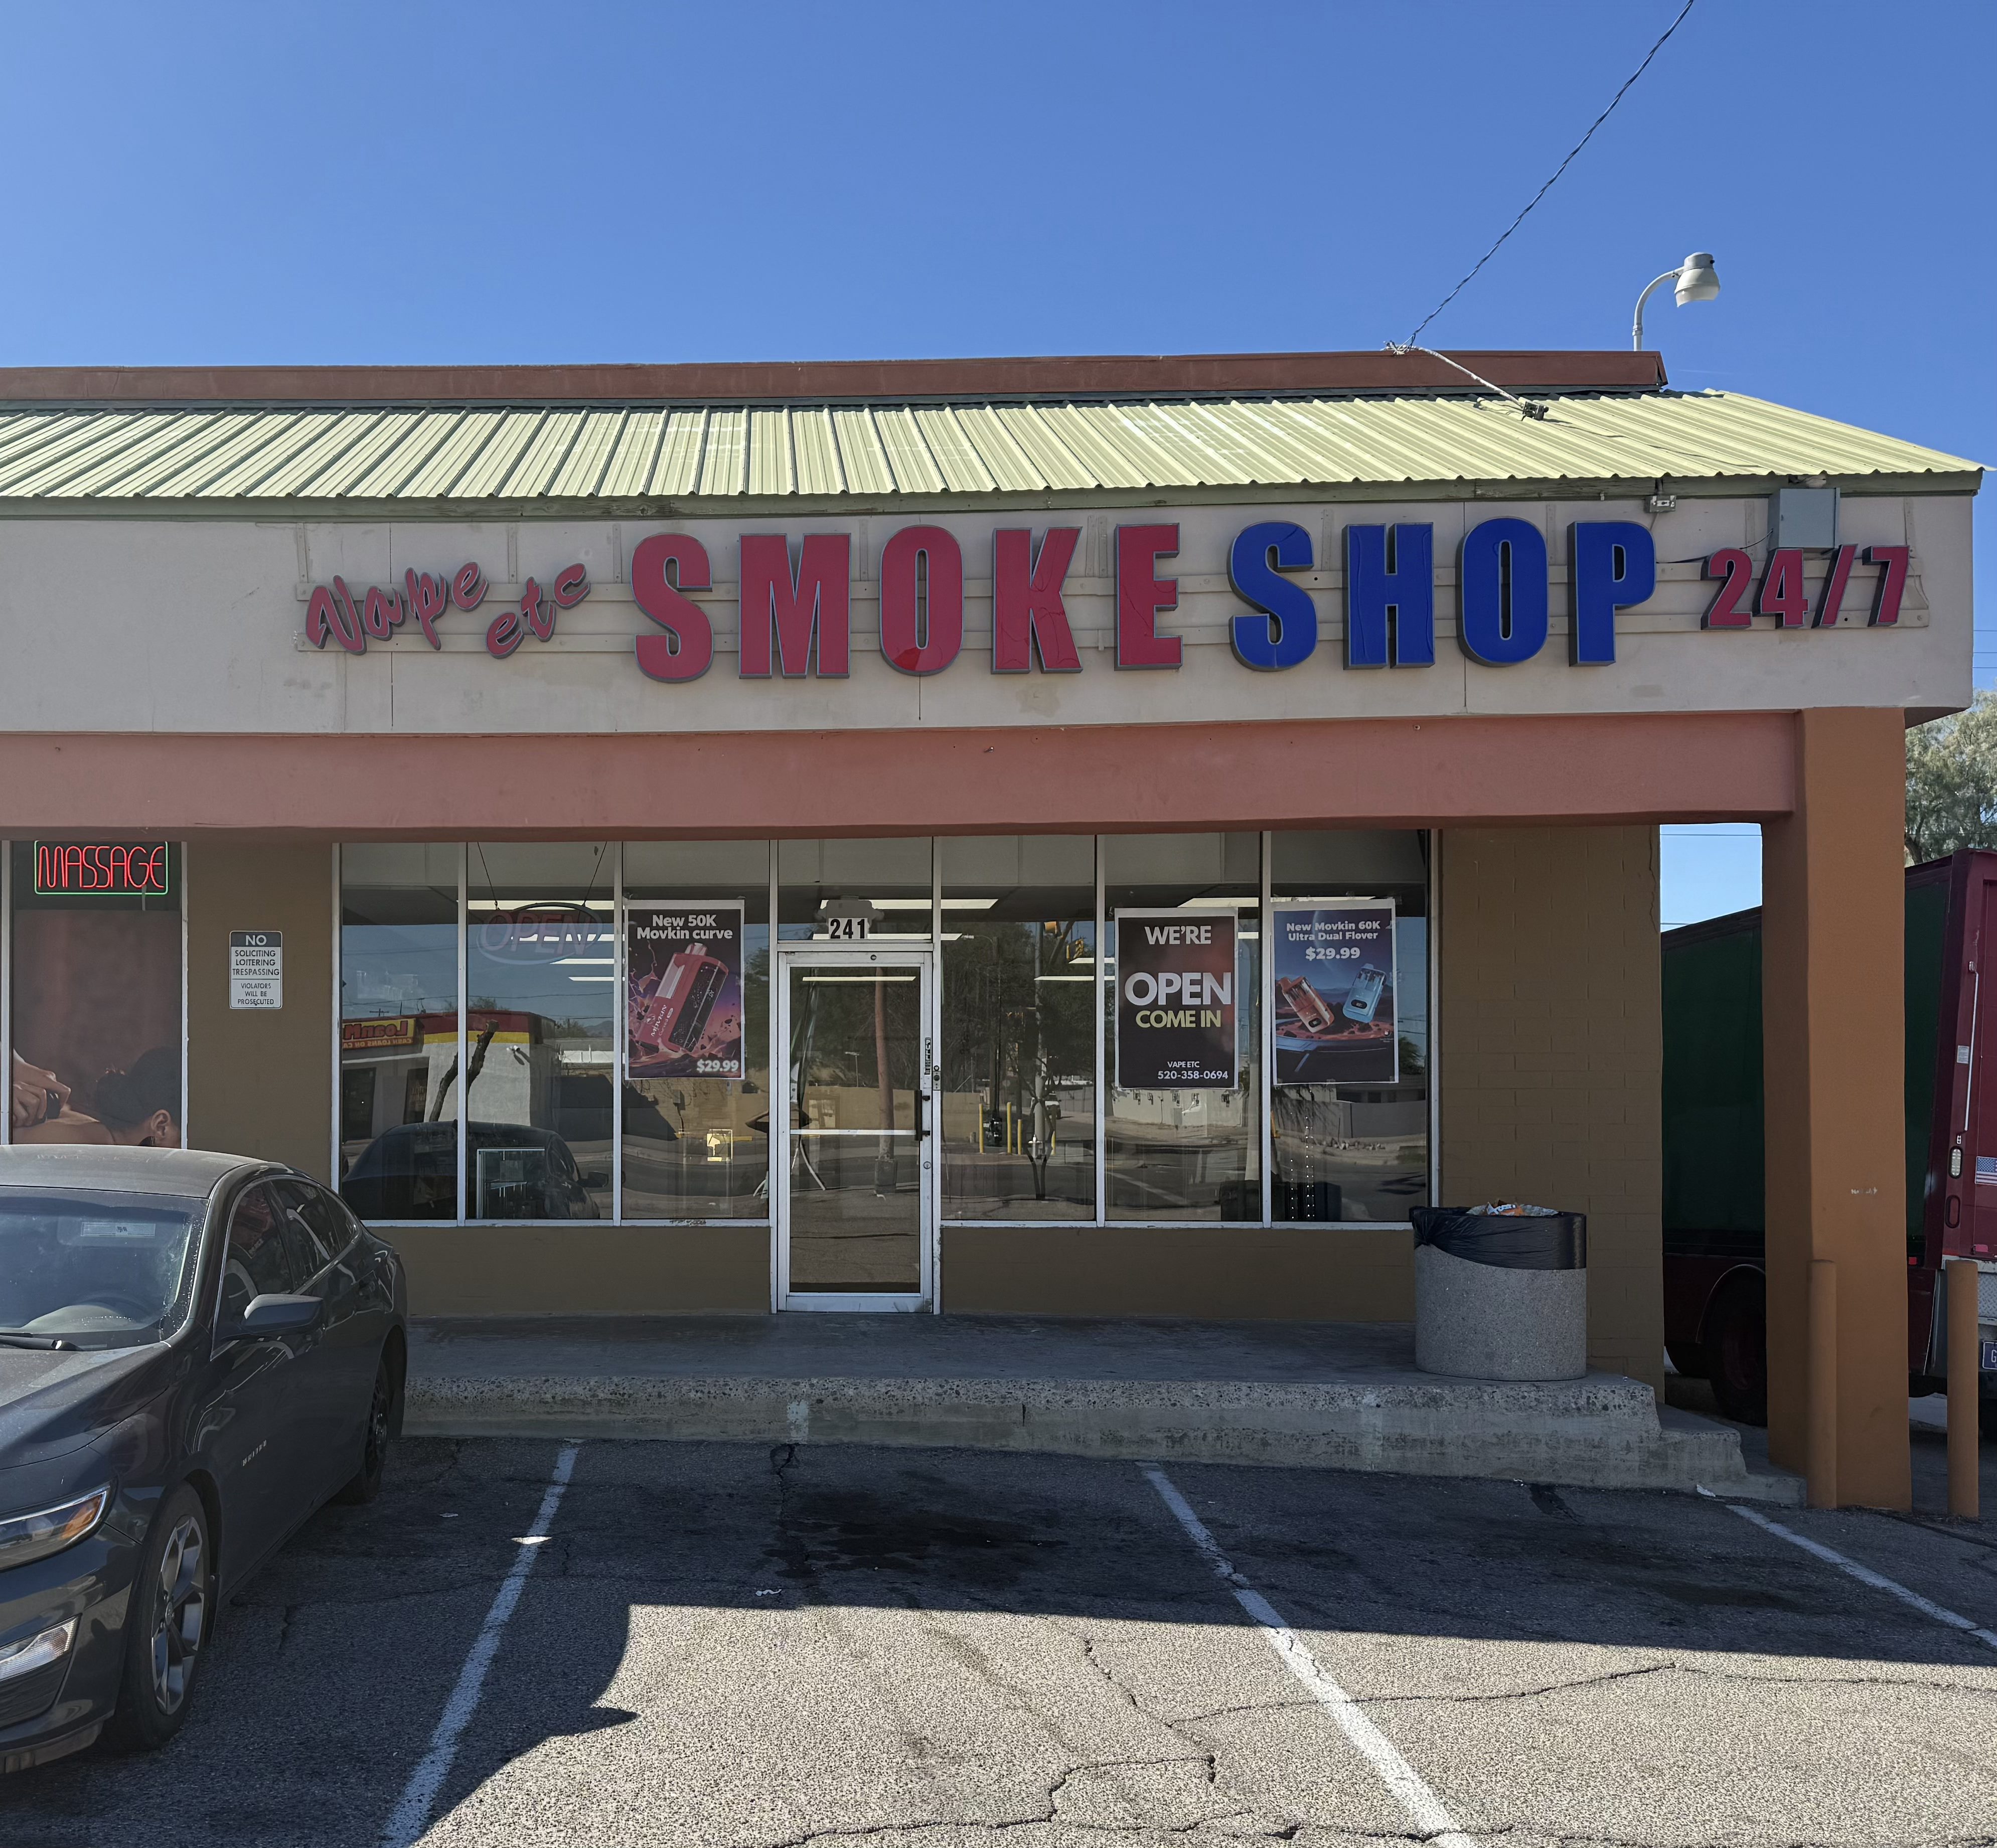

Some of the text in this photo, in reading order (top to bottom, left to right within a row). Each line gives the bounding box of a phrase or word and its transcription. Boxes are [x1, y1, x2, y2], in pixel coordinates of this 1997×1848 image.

[631, 516, 1910, 683] SMOKE SHOP 24/7
[486, 562, 591, 660] etc
[38, 846, 165, 888] MASSAGE
[653, 914, 717, 927] New 50K
[1286, 920, 1380, 932] New Movkin 60K
[482, 910, 591, 956] OPEN
[637, 927, 733, 940] Movkin curve
[830, 918, 865, 939] 241
[245, 935, 267, 946] NO
[1288, 931, 1378, 941] Ultra Dual Flover
[1305, 947, 1360, 961] $29.99
[1125, 972, 1232, 1006] OPEN
[1136, 1010, 1221, 1028] COME IN
[696, 1059, 739, 1073] $29.99
[1158, 1070, 1228, 1080] 520-358-0694
